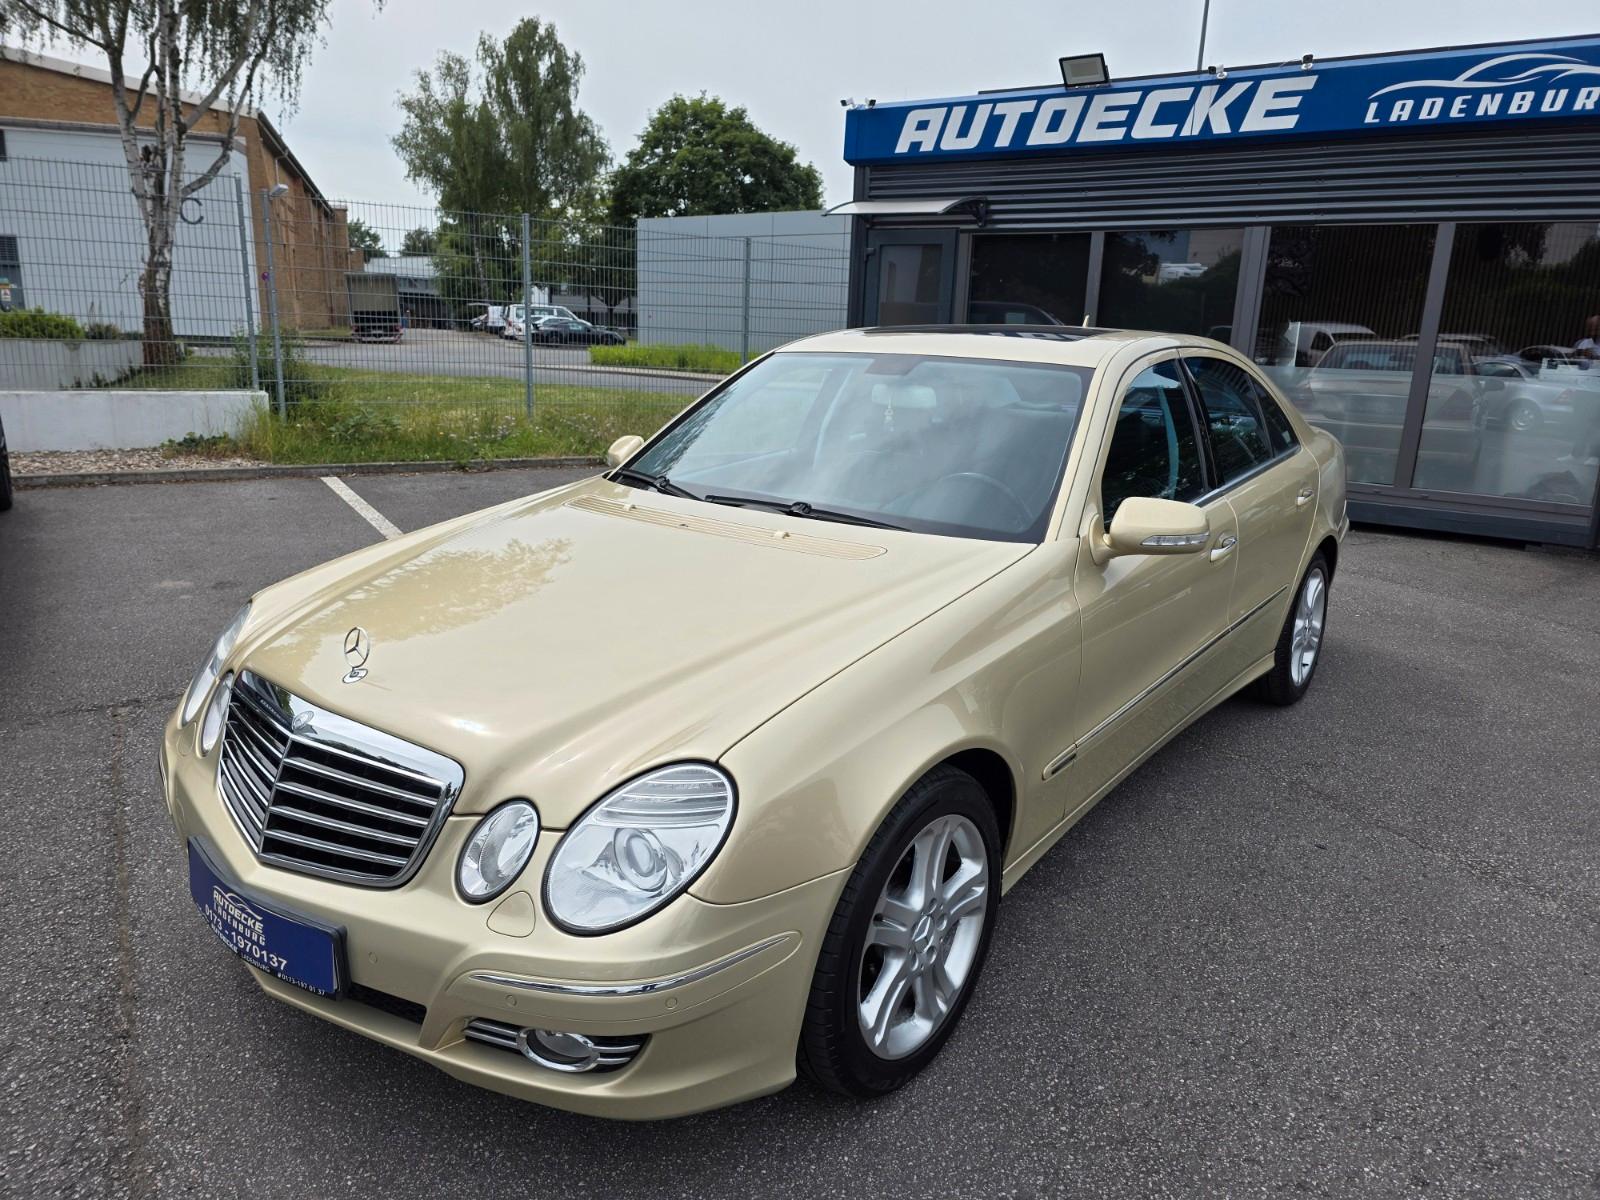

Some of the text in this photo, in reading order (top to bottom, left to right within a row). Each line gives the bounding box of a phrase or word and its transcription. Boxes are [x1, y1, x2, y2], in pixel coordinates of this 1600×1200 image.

[894, 75, 1318, 154] AUTOECKE
[205, 904, 223, 931] 0173
[231, 931, 288, 971] 1970137
[213, 890, 264, 933] AUTOECKE
[213, 901, 266, 946] LADENBURG
